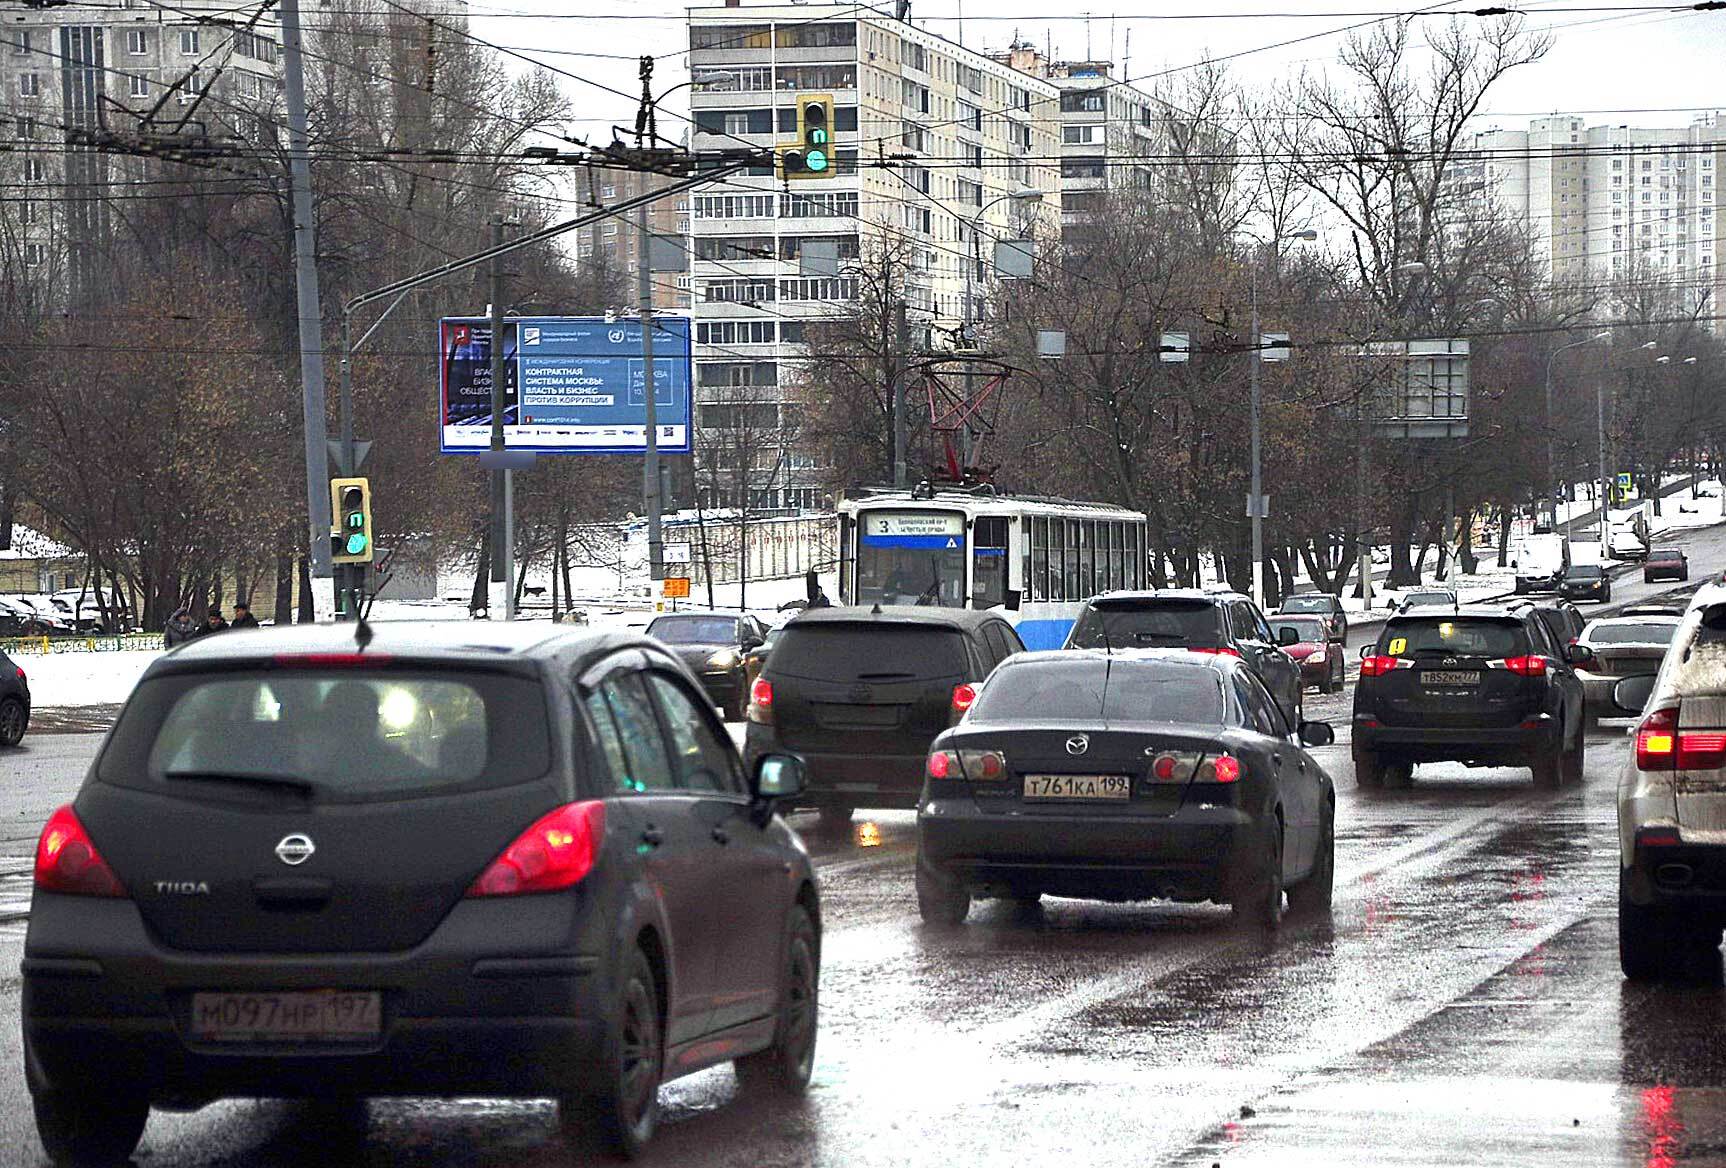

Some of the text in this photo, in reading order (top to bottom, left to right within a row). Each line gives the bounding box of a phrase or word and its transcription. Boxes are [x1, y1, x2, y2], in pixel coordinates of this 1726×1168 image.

[560, 396, 609, 404] КОРРУПЦИИ
[879, 520, 889, 533] 3
[1030, 776, 1096, 795] Т761КА
[1100, 778, 1125, 791] 199
[153, 881, 210, 894] TIIDA
[200, 993, 372, 1028] М097НР 197
